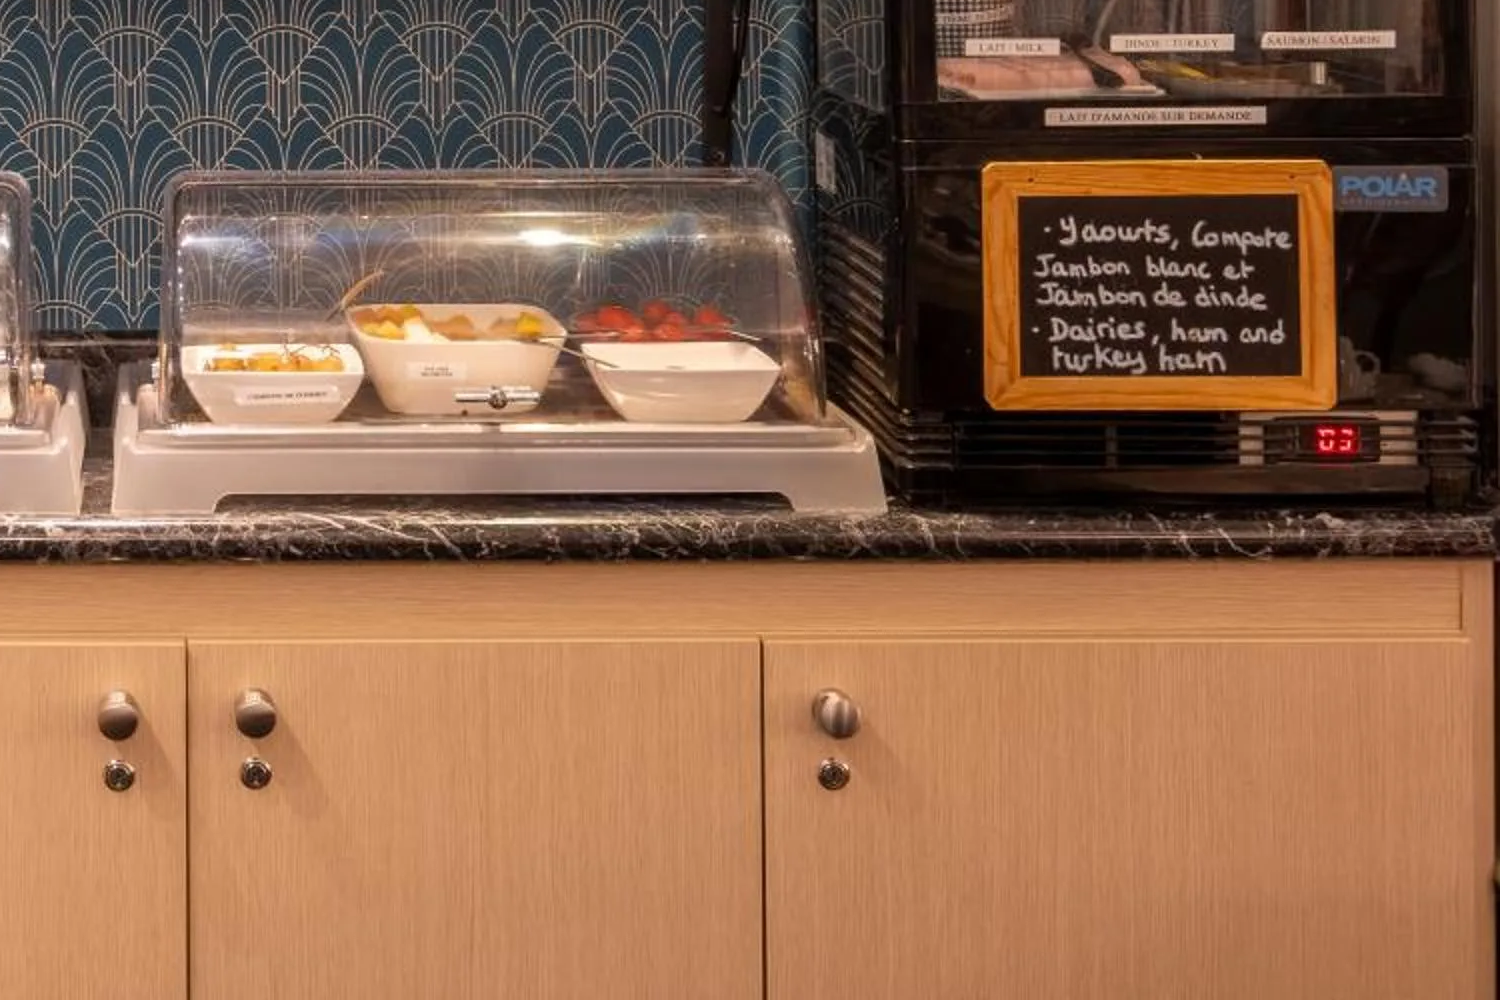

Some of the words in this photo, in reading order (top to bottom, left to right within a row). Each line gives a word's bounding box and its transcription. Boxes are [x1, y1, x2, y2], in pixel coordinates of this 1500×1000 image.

[1015, 43, 1044, 53] MILK
[1058, 112, 1088, 123] LAIT
[1161, 111, 1185, 121] SUR
[1189, 110, 1253, 121] DEMANDE
[1340, 175, 1437, 198] POLAR
[1190, 219, 1294, 256] Compote
[1032, 253, 1132, 279] Jambon
[1146, 255, 1212, 279] blanc
[1223, 260, 1256, 281] et
[1035, 282, 1148, 308] Jambon
[1152, 281, 1188, 308] de
[1195, 284, 1269, 311] dinde
[1170, 317, 1229, 344] ham
[1239, 318, 1287, 345] and
[1051, 342, 1148, 376] turkey
[1158, 344, 1228, 374] ham
[1317, 428, 1354, 452] 03
